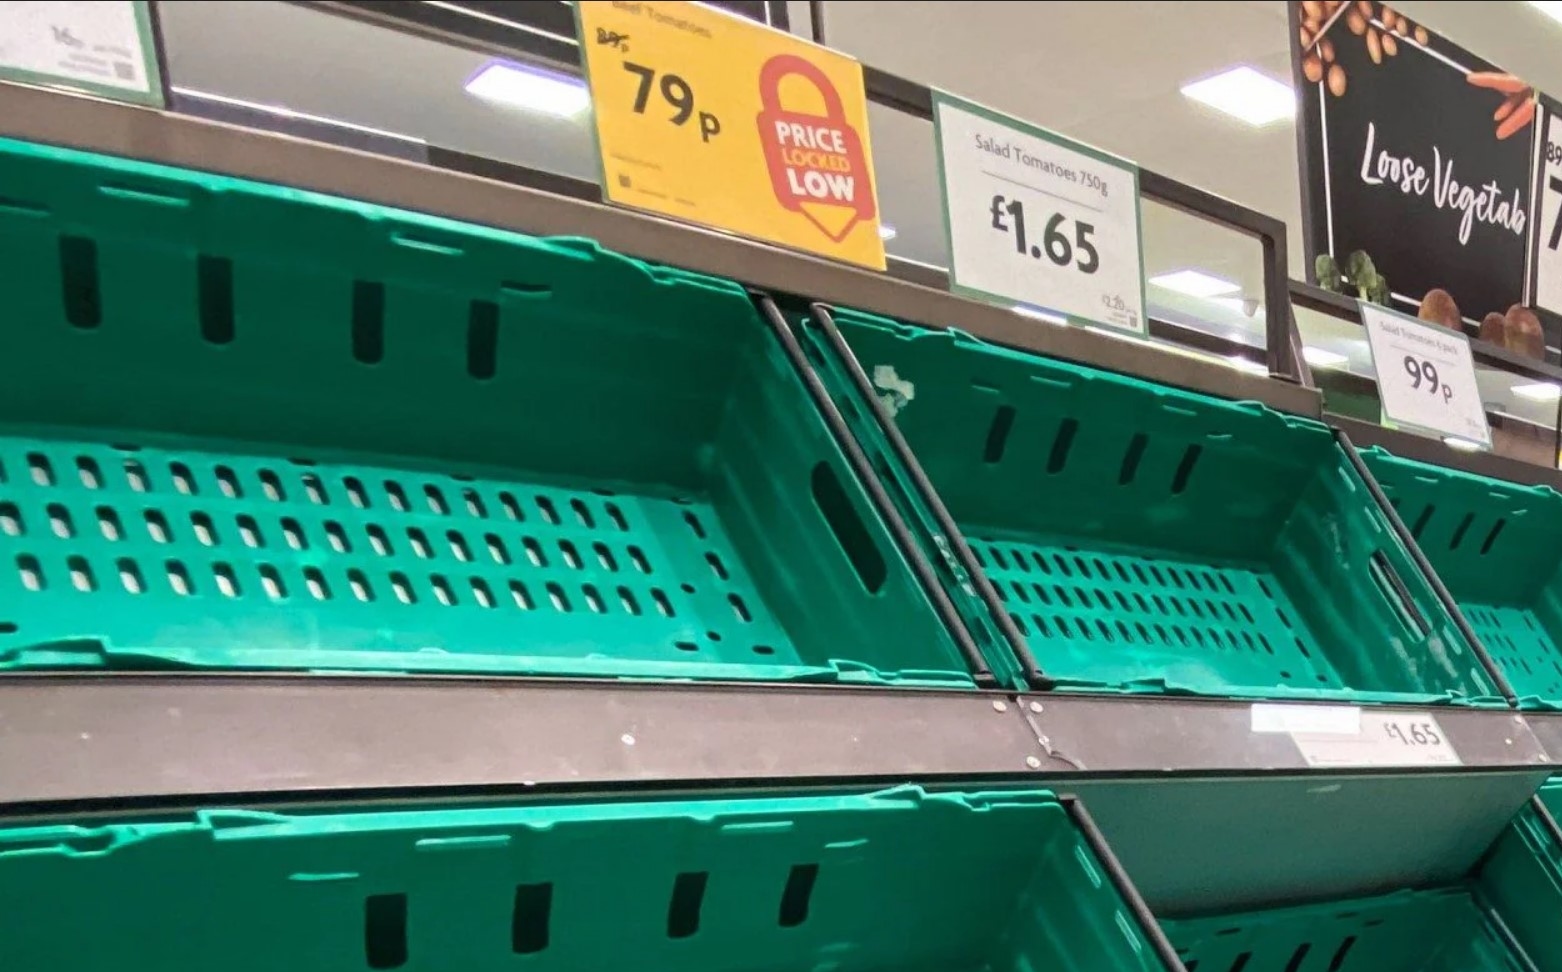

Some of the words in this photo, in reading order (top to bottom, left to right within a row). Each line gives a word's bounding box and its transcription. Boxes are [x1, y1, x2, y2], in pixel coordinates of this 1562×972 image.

[623, 61, 721, 143] 79p
[775, 120, 847, 154] PRICE
[782, 147, 851, 173] LOCKED
[1361, 121, 1430, 196] Loose
[786, 168, 855, 202] LOW
[976, 134, 1010, 159] Salad
[1013, 146, 1077, 182] Tomatoes
[1079, 170, 1108, 197] 750g
[990, 195, 1099, 274] £1.65
[1404, 356, 1453, 404] 99p
[1383, 722, 1441, 745] £1.65
